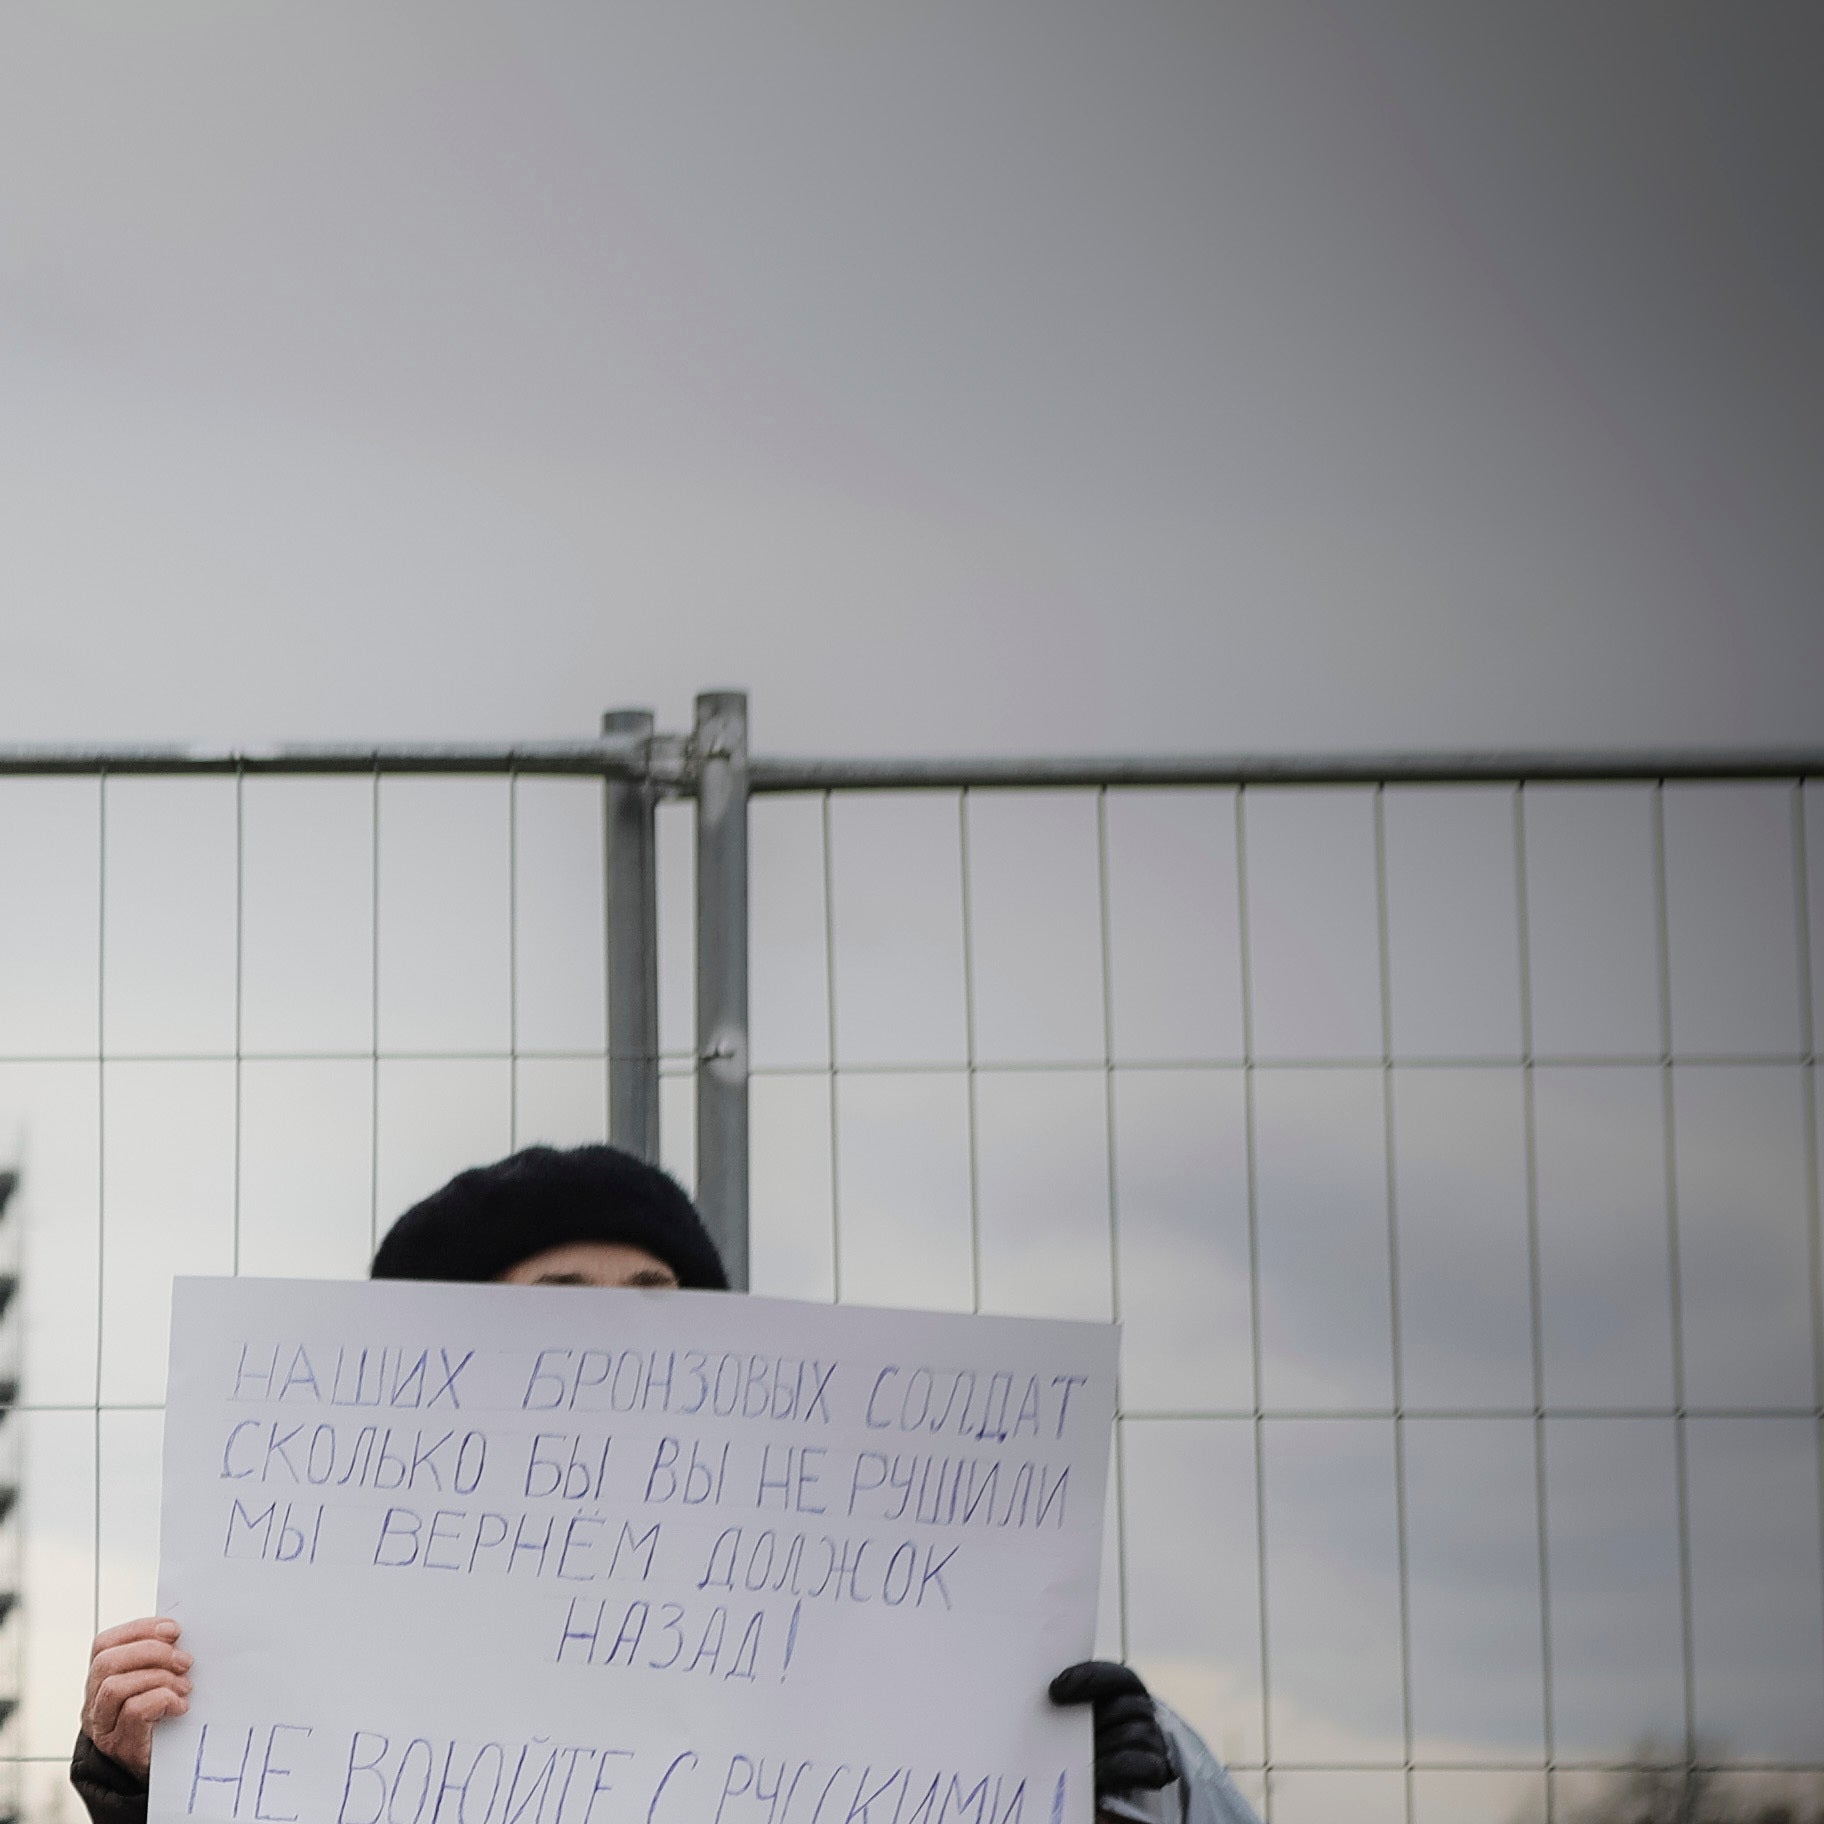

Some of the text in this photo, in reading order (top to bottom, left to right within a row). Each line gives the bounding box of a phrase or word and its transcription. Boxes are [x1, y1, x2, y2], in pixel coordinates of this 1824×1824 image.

[232, 1344, 1088, 1443] НАШИХ БРОНЗОВЫХ СОЛДАТ
[220, 1420, 1072, 1528] СКОЛЬКО БЫ ВЫ НЕ РУШИЛИ
[224, 1498, 961, 1610] МЫ ВЕРНЁМ ДОЛЖОК
[557, 1597, 801, 1684] НАЗАД!
[188, 1723, 313, 1821] НЕ
